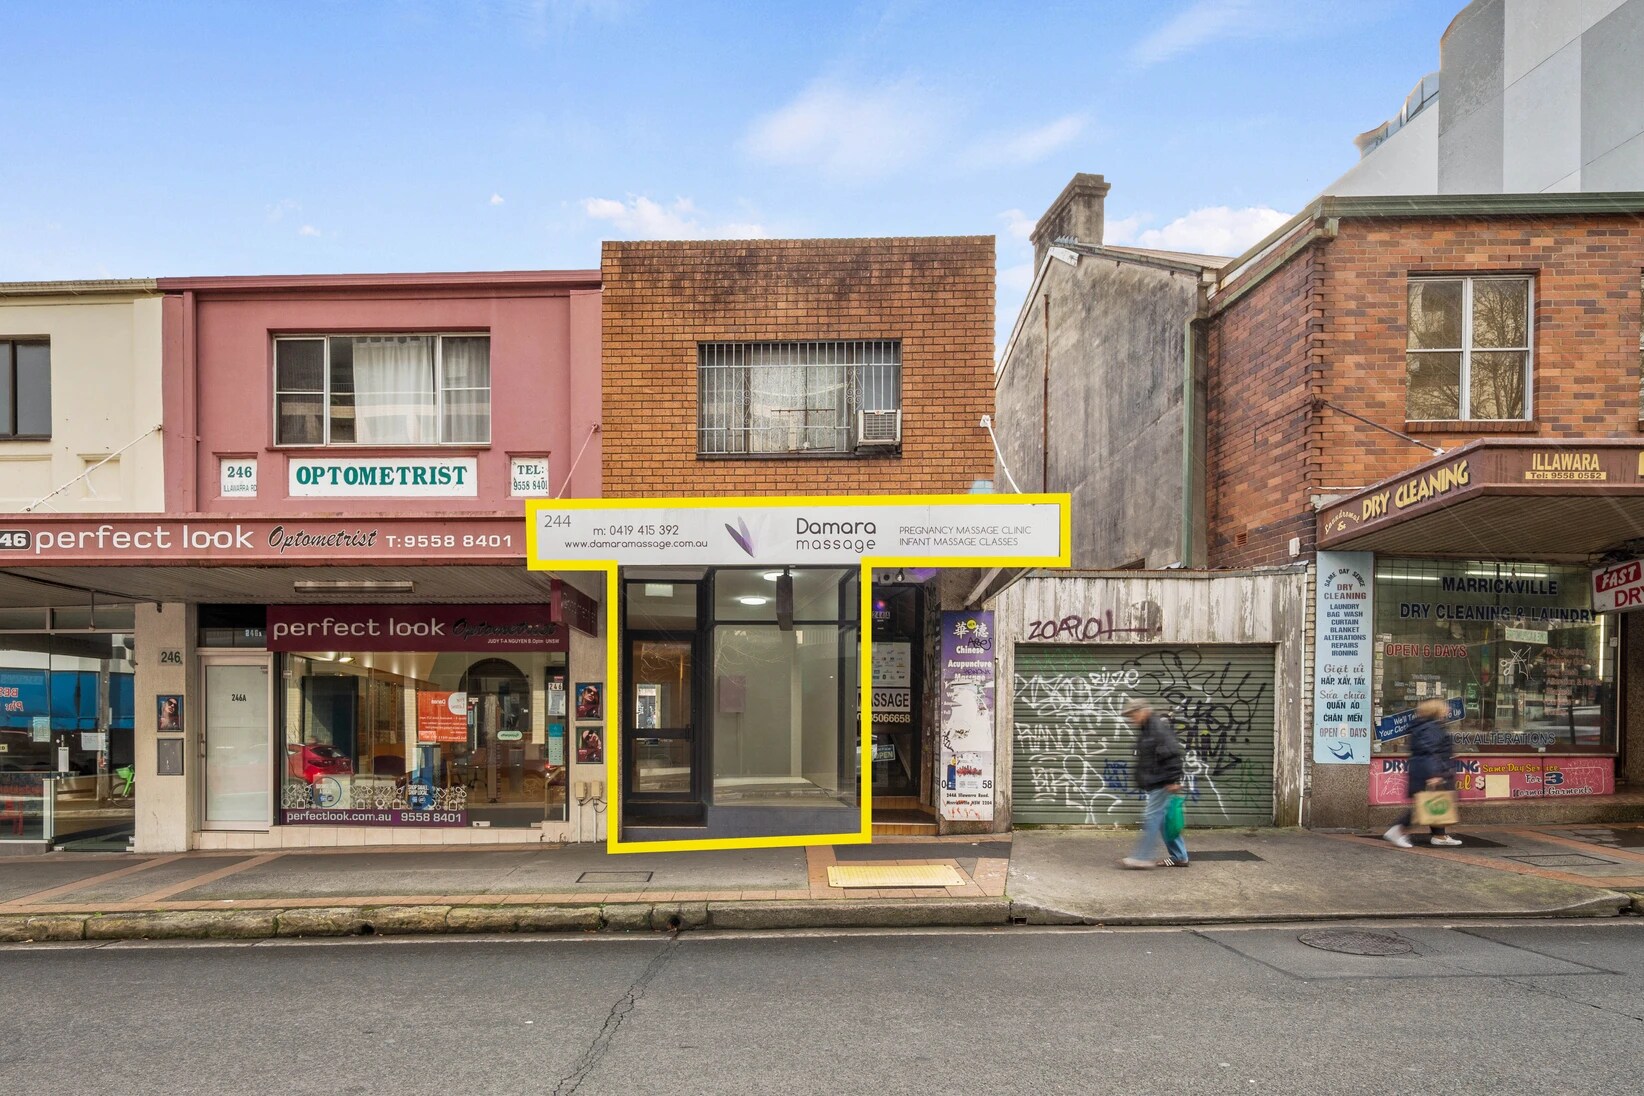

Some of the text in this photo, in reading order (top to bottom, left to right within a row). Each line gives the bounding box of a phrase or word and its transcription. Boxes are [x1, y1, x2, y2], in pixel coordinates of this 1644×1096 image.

[1532, 454, 1599, 470] ILLAWARA
[227, 466, 252, 478] 246
[296, 466, 468, 485] OPTOMETRIST
[517, 465, 544, 474] TEL:
[514, 480, 530, 490] 9558
[1362, 460, 1469, 521] DRY CLEANING
[544, 515, 571, 528] 244
[796, 518, 876, 534] Damara
[1337, 521, 1346, 531] &
[593, 524, 679, 535] m: 0419 415 392
[900, 525, 1032, 535] PREGNANCY MASSAGE CLINIC
[35, 525, 254, 554] perfect look
[268, 525, 379, 554] Optometrist
[386, 533, 512, 548] T:9558 8401
[565, 539, 708, 550] www.damaramassage.com.au
[796, 539, 876, 553] massage
[900, 537, 1018, 547] INFANT MASSAGE CLASSES
[1324, 572, 1337, 587] SAME
[1601, 565, 1636, 589] FAST
[1442, 576, 1558, 595] MARRICKVILLE
[1400, 603, 1595, 624] DRY CLEANING & LAUNDRY
[273, 618, 445, 640] perfect look
[956, 646, 984, 654] Chinese
[1386, 643, 1468, 657] OPEN 6 DAYS
[948, 660, 992, 669] Acupuncture
[858, 693, 909, 707] SSAGE
[1320, 728, 1367, 737] OPEN 6 DAYS
[1379, 729, 1394, 738] Your
[1450, 732, 1555, 745] ICK ALTERATIONS
[1482, 765, 1506, 773] Same
[1508, 764, 1524, 773] Day
[1525, 764, 1557, 772] Serice
[1525, 774, 1542, 783] For
[1545, 772, 1564, 785] 3
[1548, 786, 1592, 796] Garments
[287, 811, 462, 824] perfectlook.com.au 9558 8401
